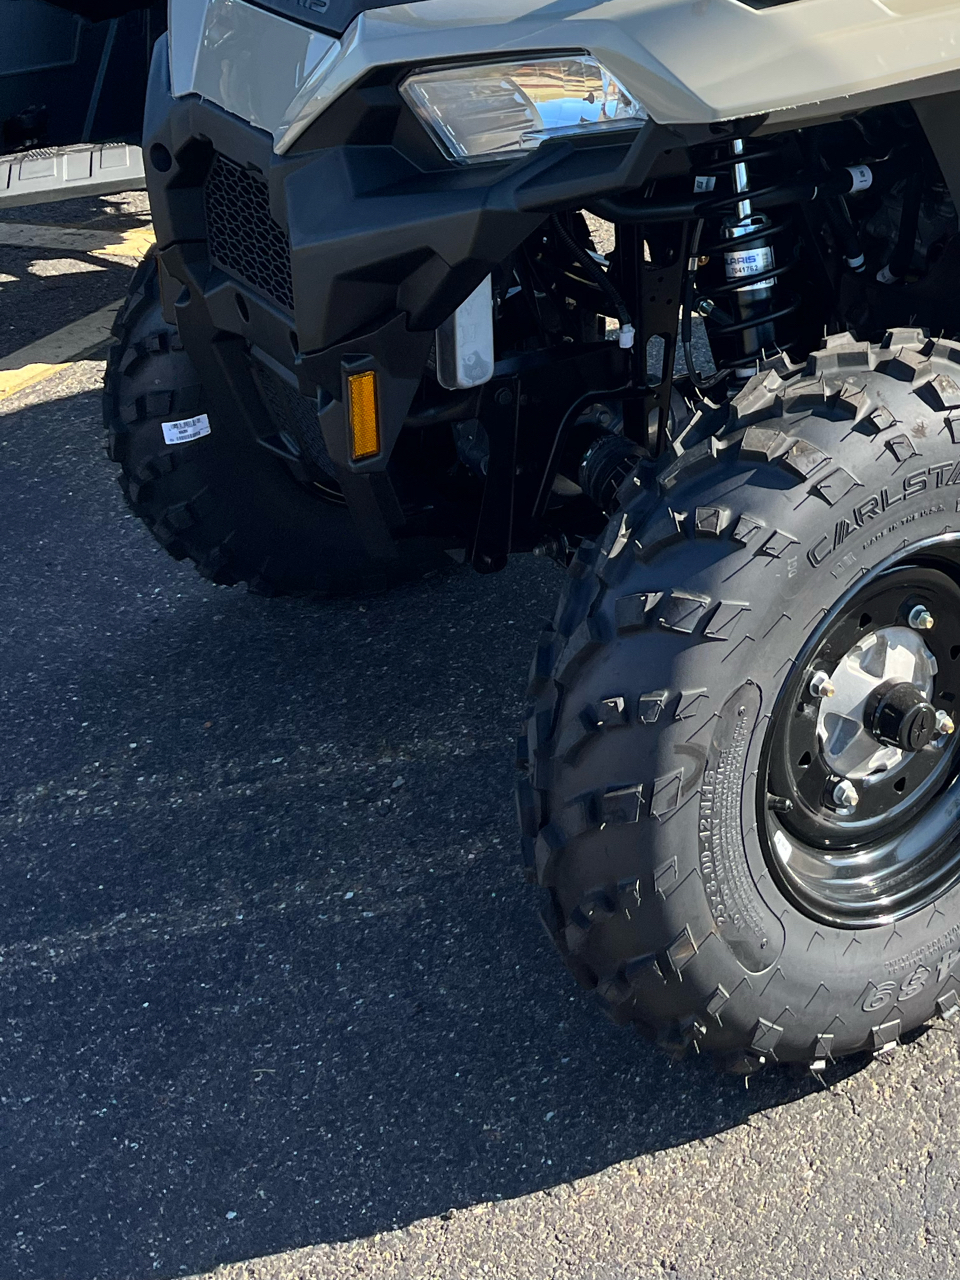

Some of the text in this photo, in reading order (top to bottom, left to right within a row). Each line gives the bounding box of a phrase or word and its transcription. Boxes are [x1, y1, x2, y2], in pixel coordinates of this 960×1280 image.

[863, 529, 888, 550] MADE
[714, 749, 729, 813] SERVICE
[713, 819, 726, 880] HIGHWAY
[719, 883, 736, 909] FOR
